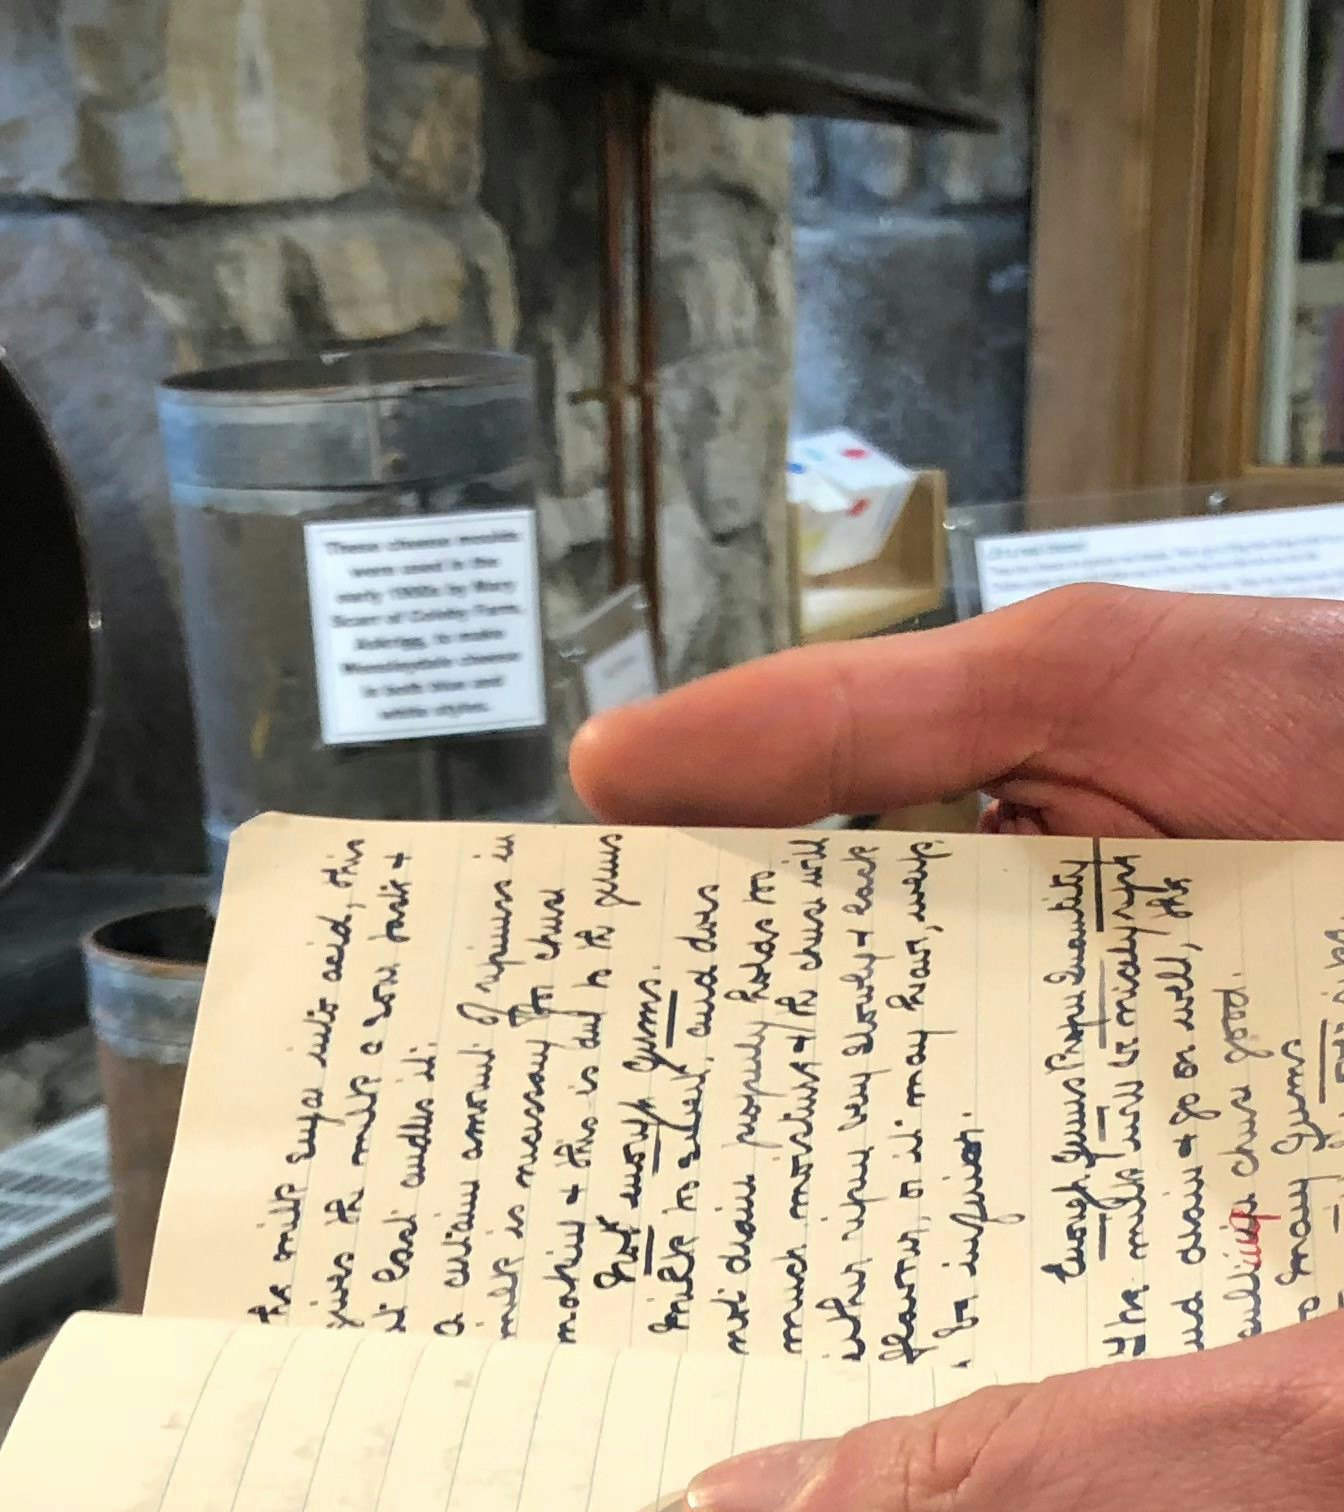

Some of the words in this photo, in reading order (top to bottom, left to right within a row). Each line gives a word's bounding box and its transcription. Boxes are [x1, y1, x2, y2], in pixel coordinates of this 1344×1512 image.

[472, 834, 515, 861] in
[306, 902, 366, 981] acid,
[674, 883, 720, 952] does
[723, 917, 779, 1002] holds
[1152, 941, 1203, 1030] well,
[286, 997, 338, 1067] into
[685, 964, 717, 1037] and
[1211, 971, 1274, 1063] good.
[567, 1065, 598, 1094] is
[897, 1028, 957, 1108] may
[1172, 1044, 1198, 1078] on
[442, 1042, 495, 1159] amount
[553, 1116, 597, 1167] this
[257, 1183, 307, 1261] milk
[433, 1179, 480, 1287] certain
[485, 1203, 524, 1238] is
[475, 1255, 524, 1339] milk
[710, 1288, 749, 1354] not
[770, 1243, 808, 1353] much
[1169, 1289, 1205, 1350] nd
